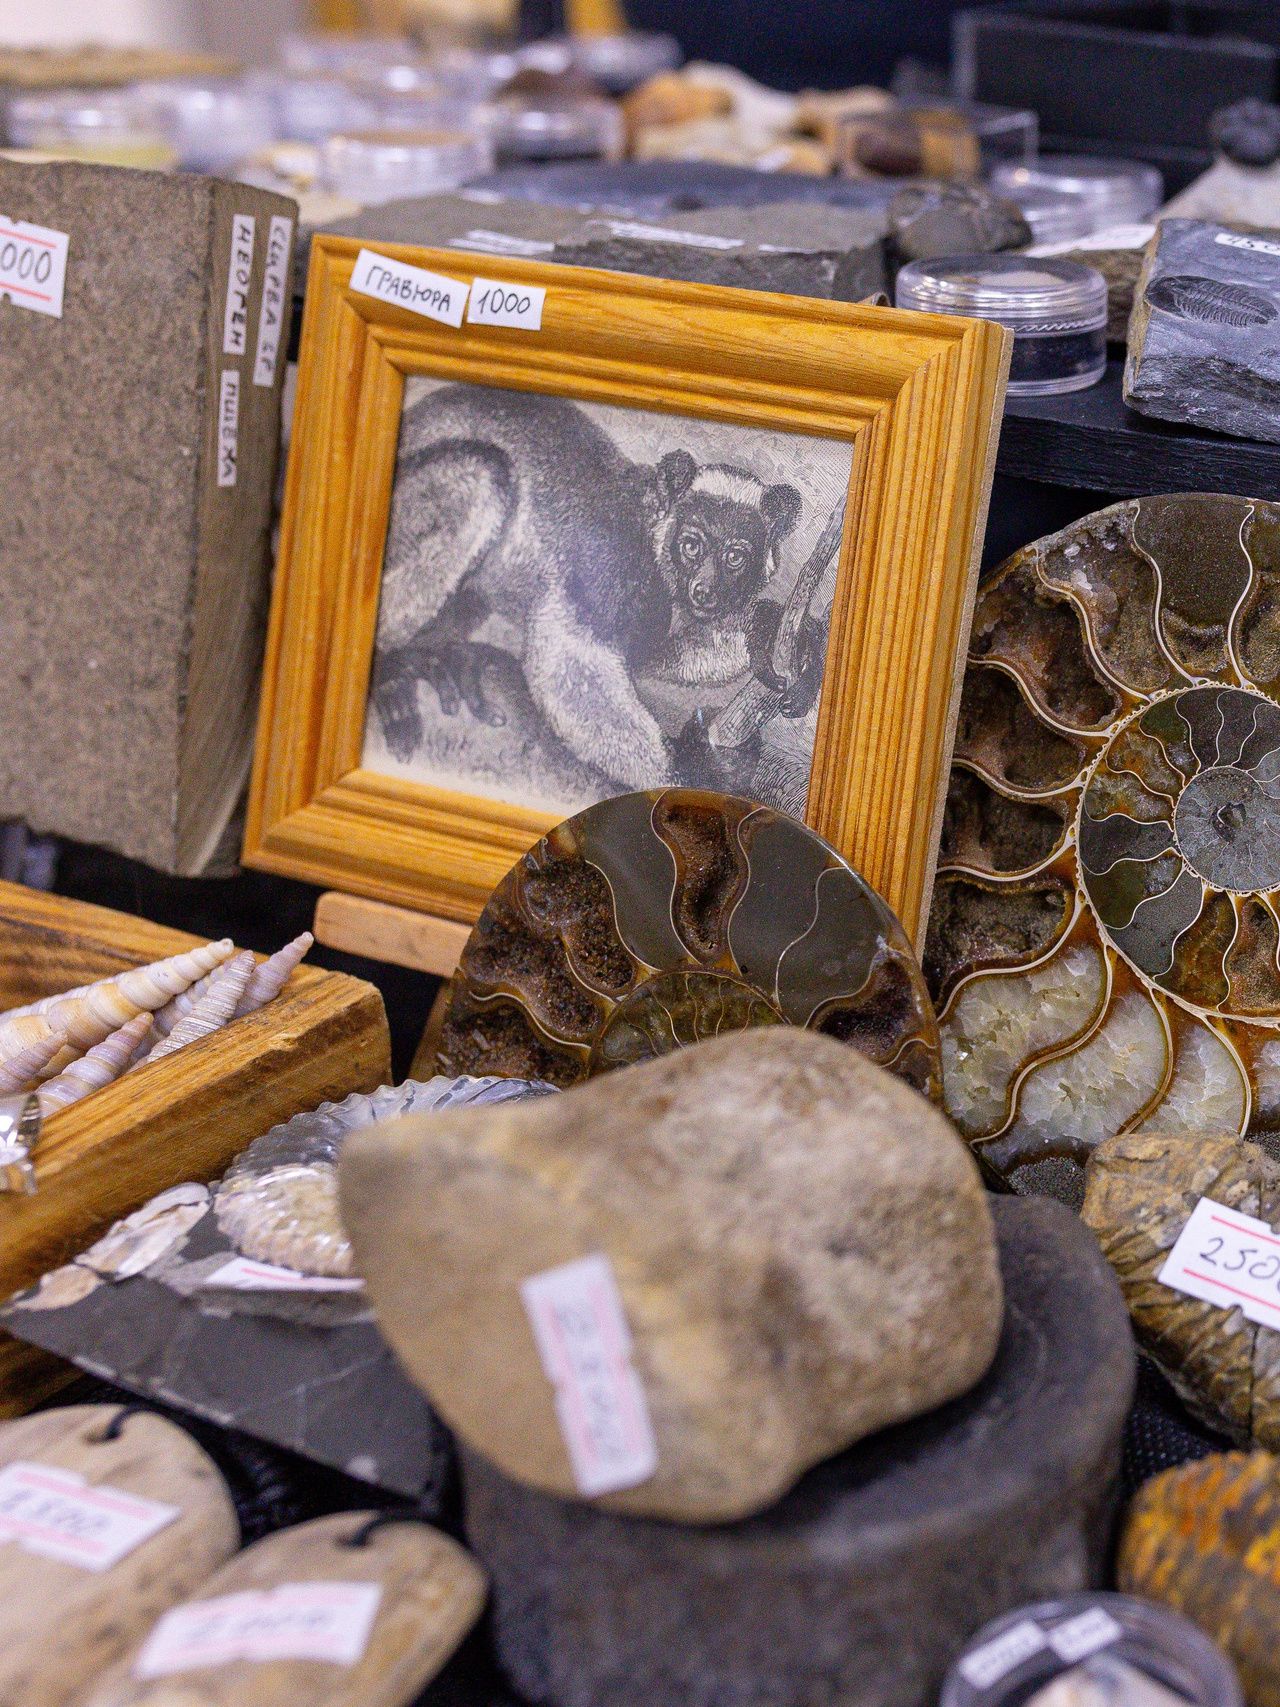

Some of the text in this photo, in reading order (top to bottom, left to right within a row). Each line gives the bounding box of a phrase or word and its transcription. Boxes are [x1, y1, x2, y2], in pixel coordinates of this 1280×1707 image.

[231, 224, 251, 346] НЕОГЕН
[365, 265, 531, 314] ГРАВЮРА 1000
